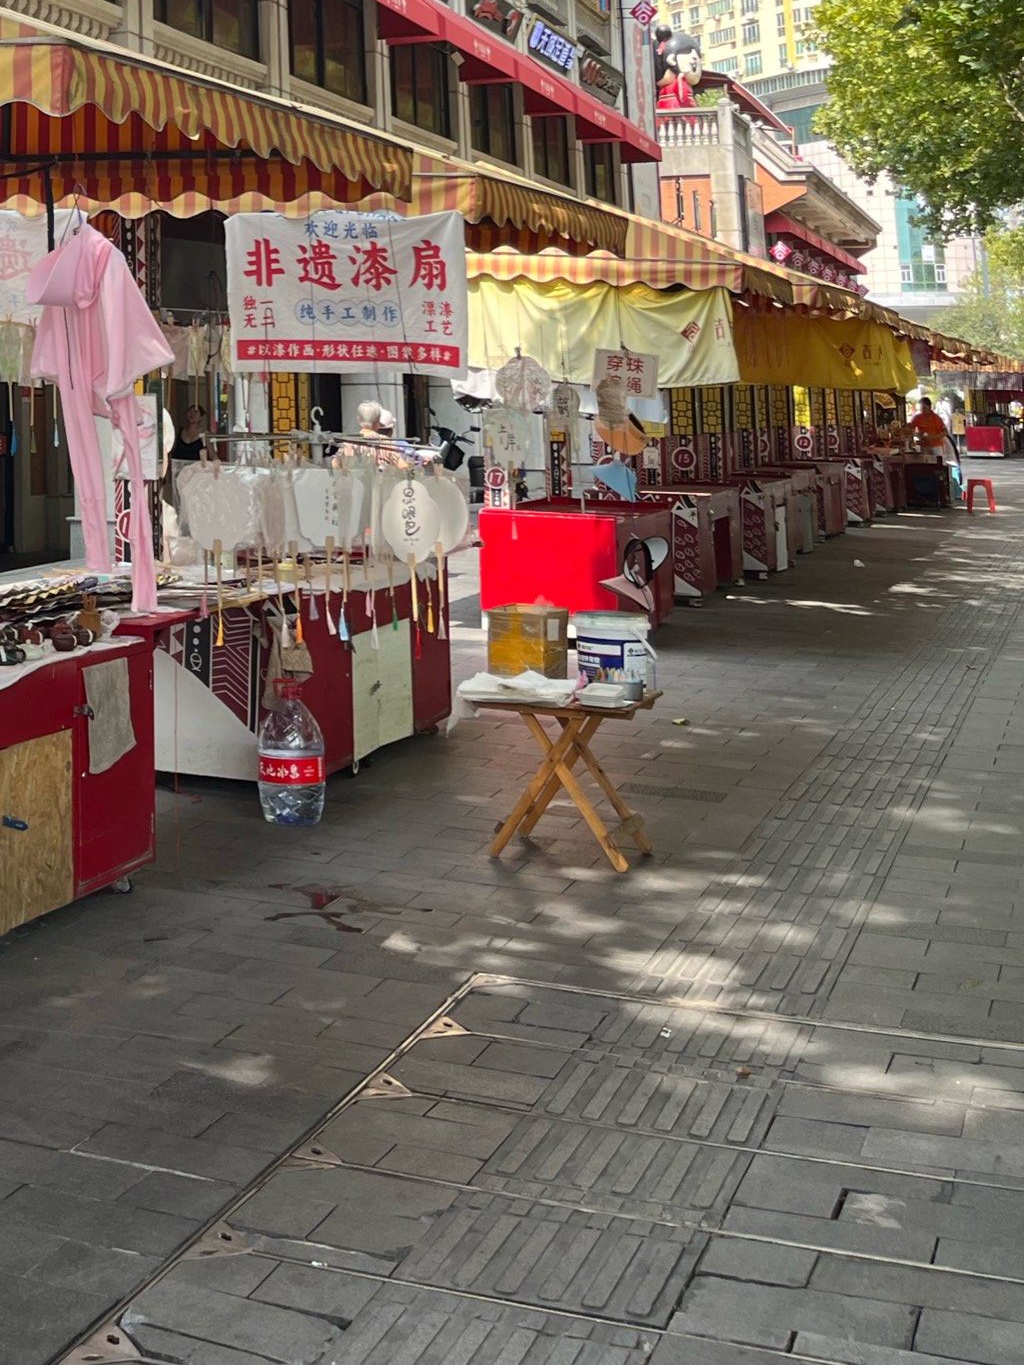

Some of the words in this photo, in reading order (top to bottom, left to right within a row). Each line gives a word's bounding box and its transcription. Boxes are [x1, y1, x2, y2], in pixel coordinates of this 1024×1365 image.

[304, 221, 378, 240] 欢迎光临
[243, 238, 447, 291] 非遗漆扇
[299, 305, 400, 322] 纯手工制作
[607, 355, 644, 374] 穿珠
[489, 472, 503, 483] 17
